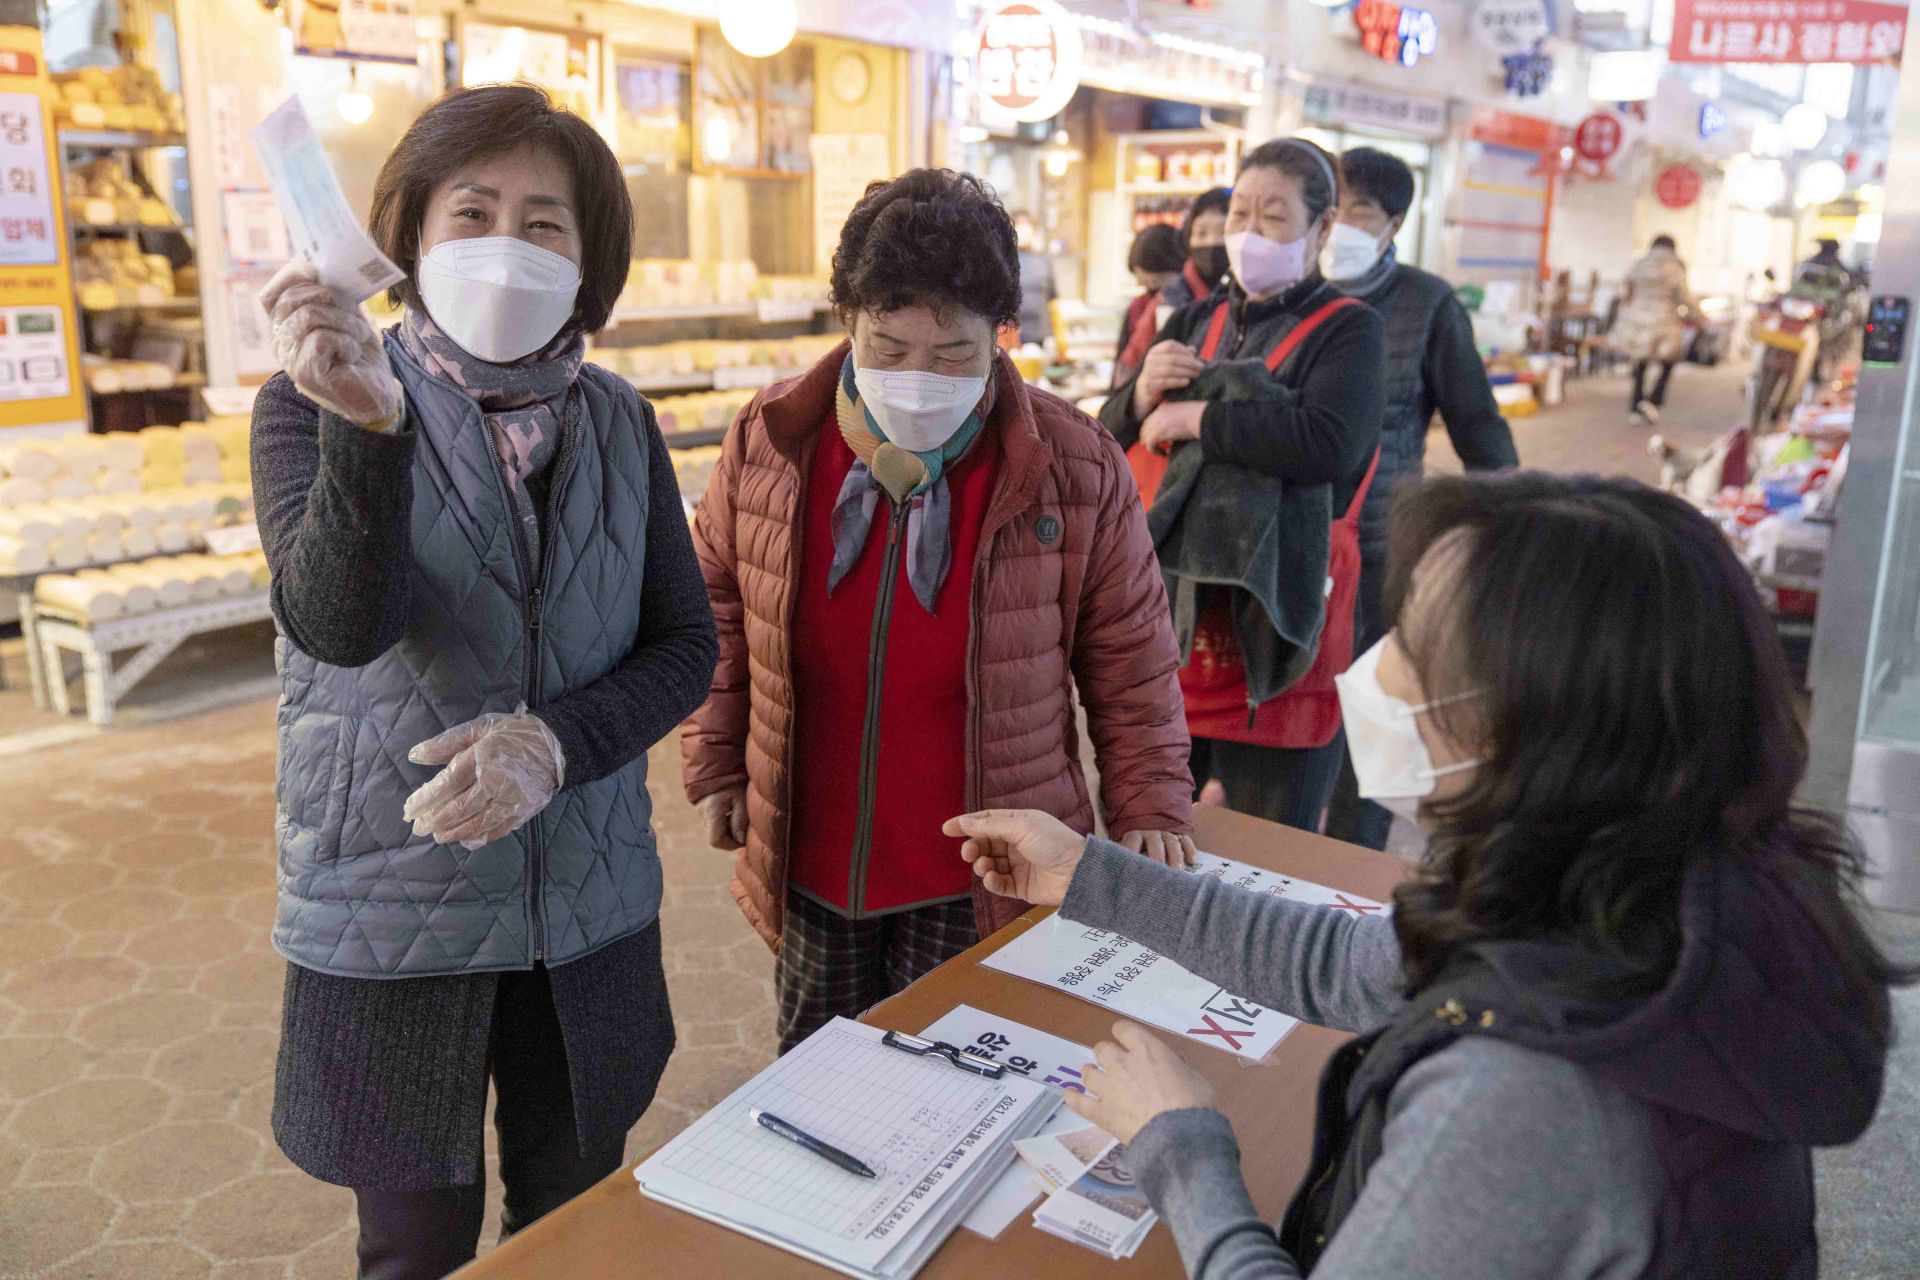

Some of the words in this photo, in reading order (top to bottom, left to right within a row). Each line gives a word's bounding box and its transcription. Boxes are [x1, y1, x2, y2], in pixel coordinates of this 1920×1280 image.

[1082, 945, 1121, 967] 상품권
[1054, 964, 1097, 987] 증정을
[1112, 964, 1144, 981] 증정
[994, 1096, 1017, 1114] 2021
